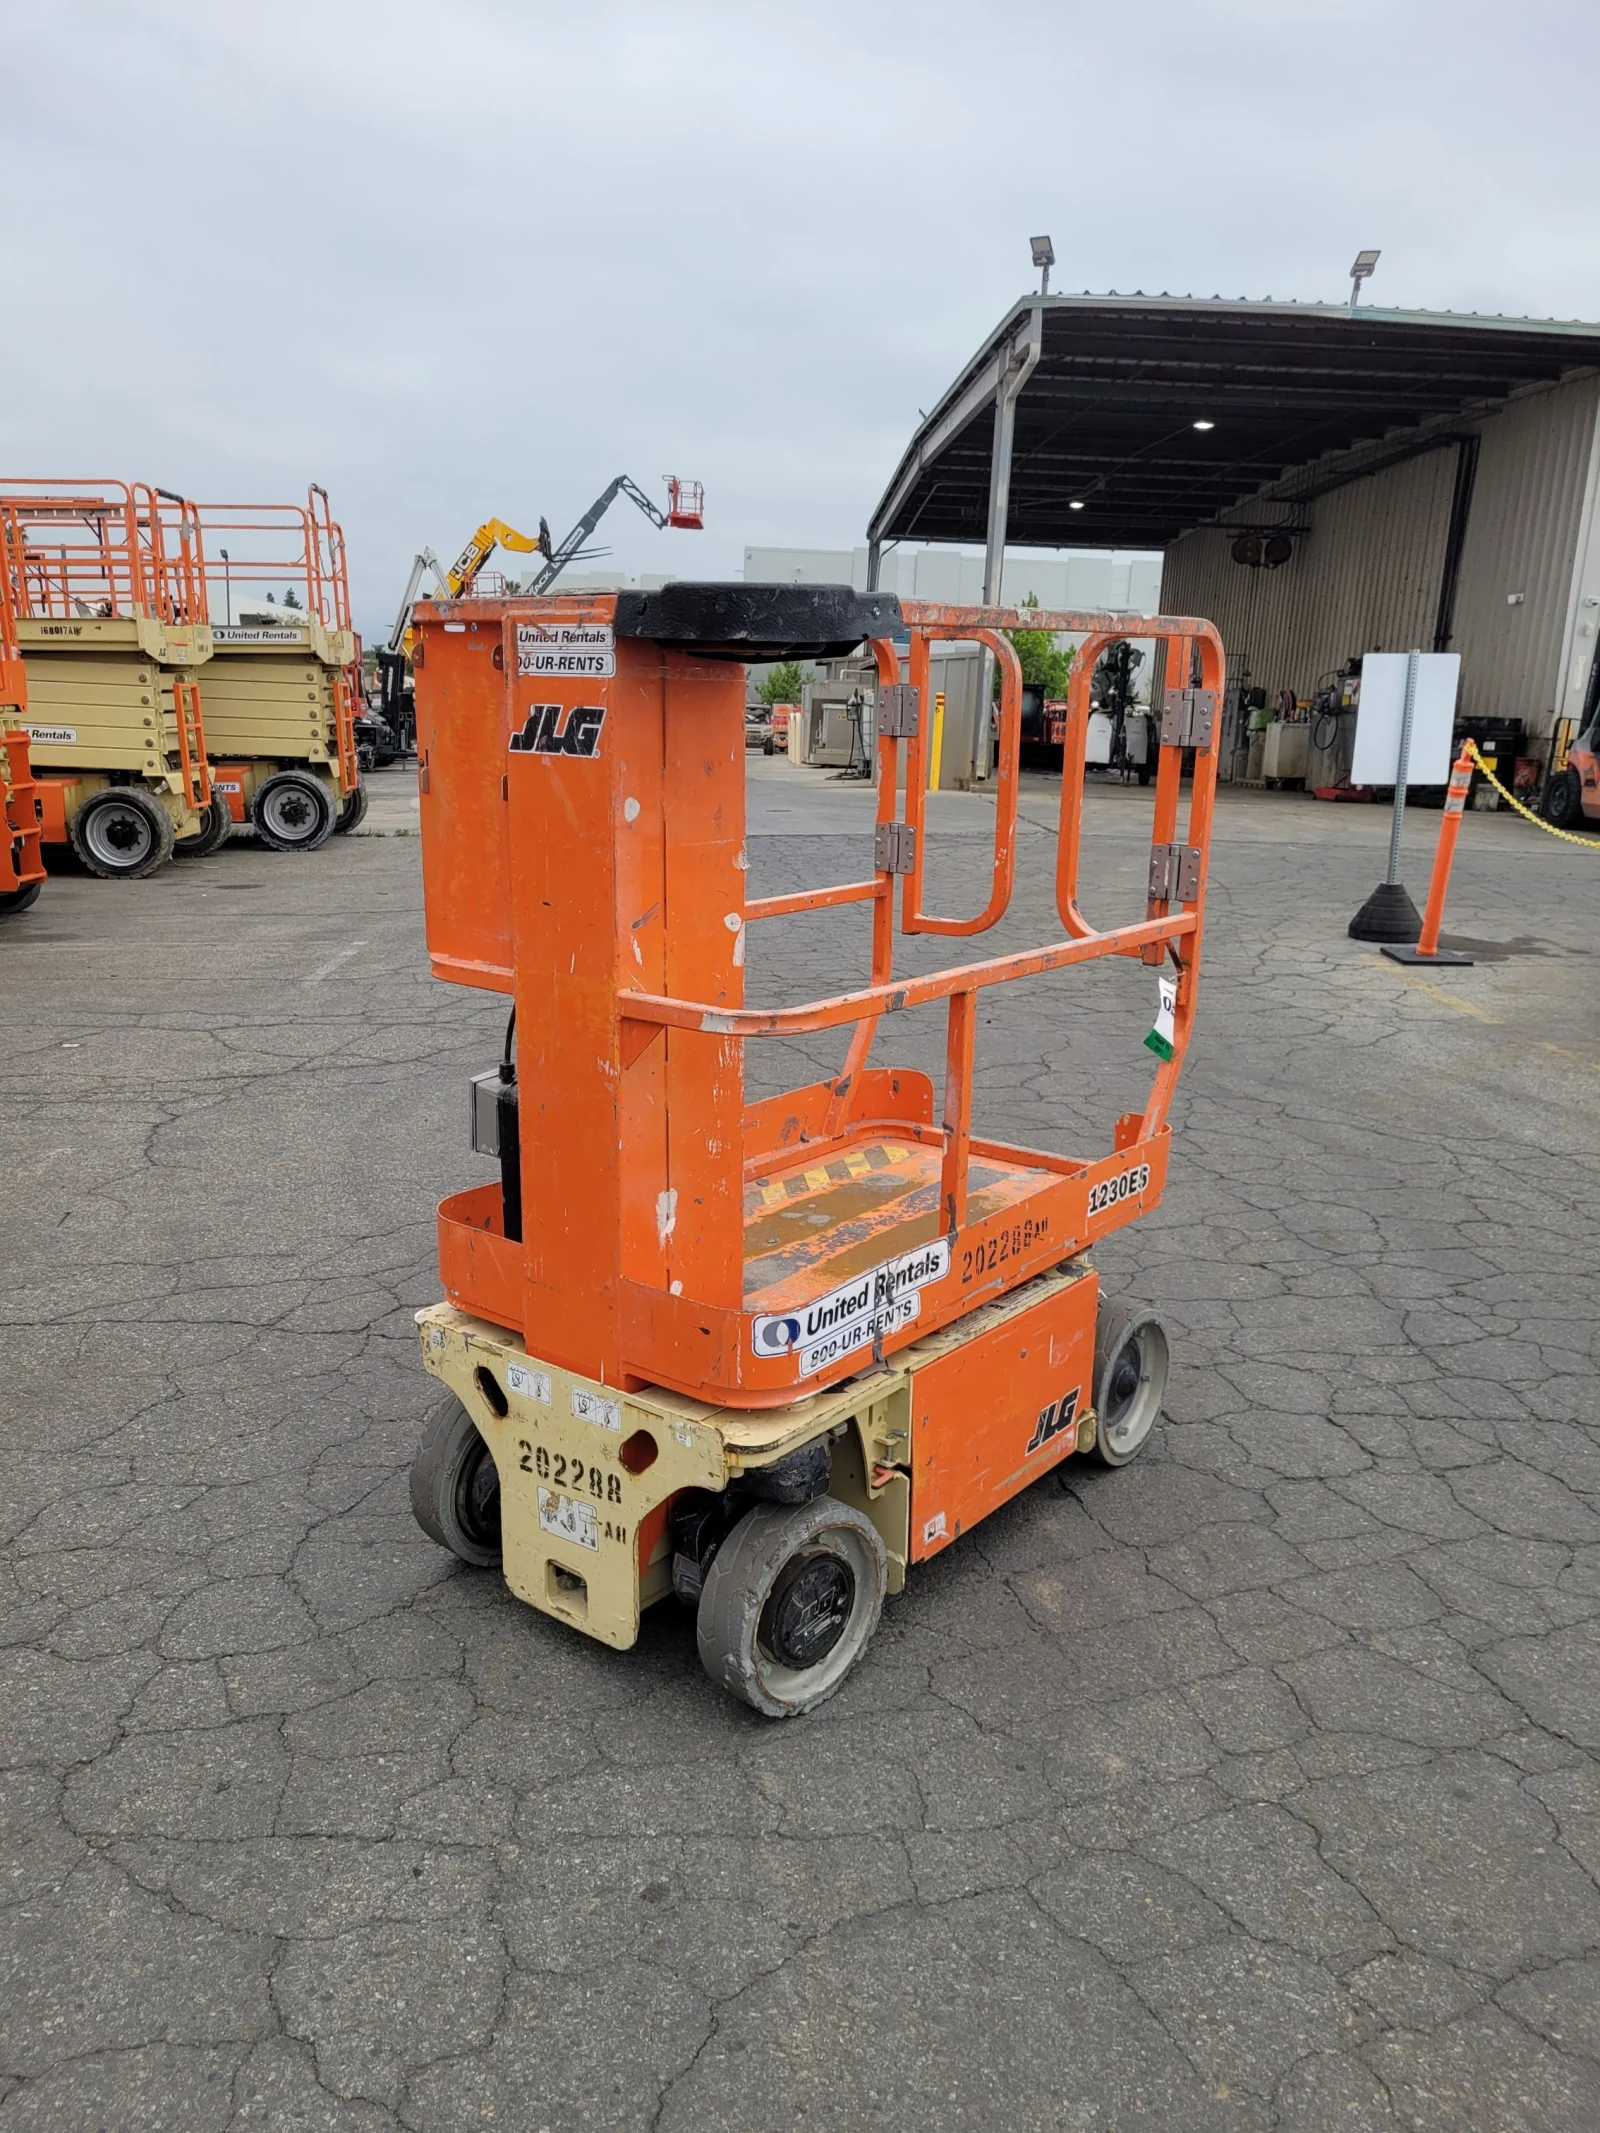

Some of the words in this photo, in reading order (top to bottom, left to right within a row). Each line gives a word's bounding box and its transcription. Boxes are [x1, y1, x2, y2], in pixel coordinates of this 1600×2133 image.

[451, 543, 480, 580] JCB
[227, 631, 260, 640] United
[262, 631, 297, 640] Rentals
[519, 630, 558, 643] United
[561, 630, 606, 643] Rentals
[32, 729, 72, 740] Rentals
[510, 704, 606, 757] JLG
[1089, 1166, 1150, 1214] 1230ES
[807, 1282, 869, 1336] United
[874, 1252, 940, 1301] Rentals
[810, 1300, 912, 1368] 800-UR-RENTS
[1026, 1386, 1081, 1456] JLG
[519, 1439, 622, 1504] 202288
